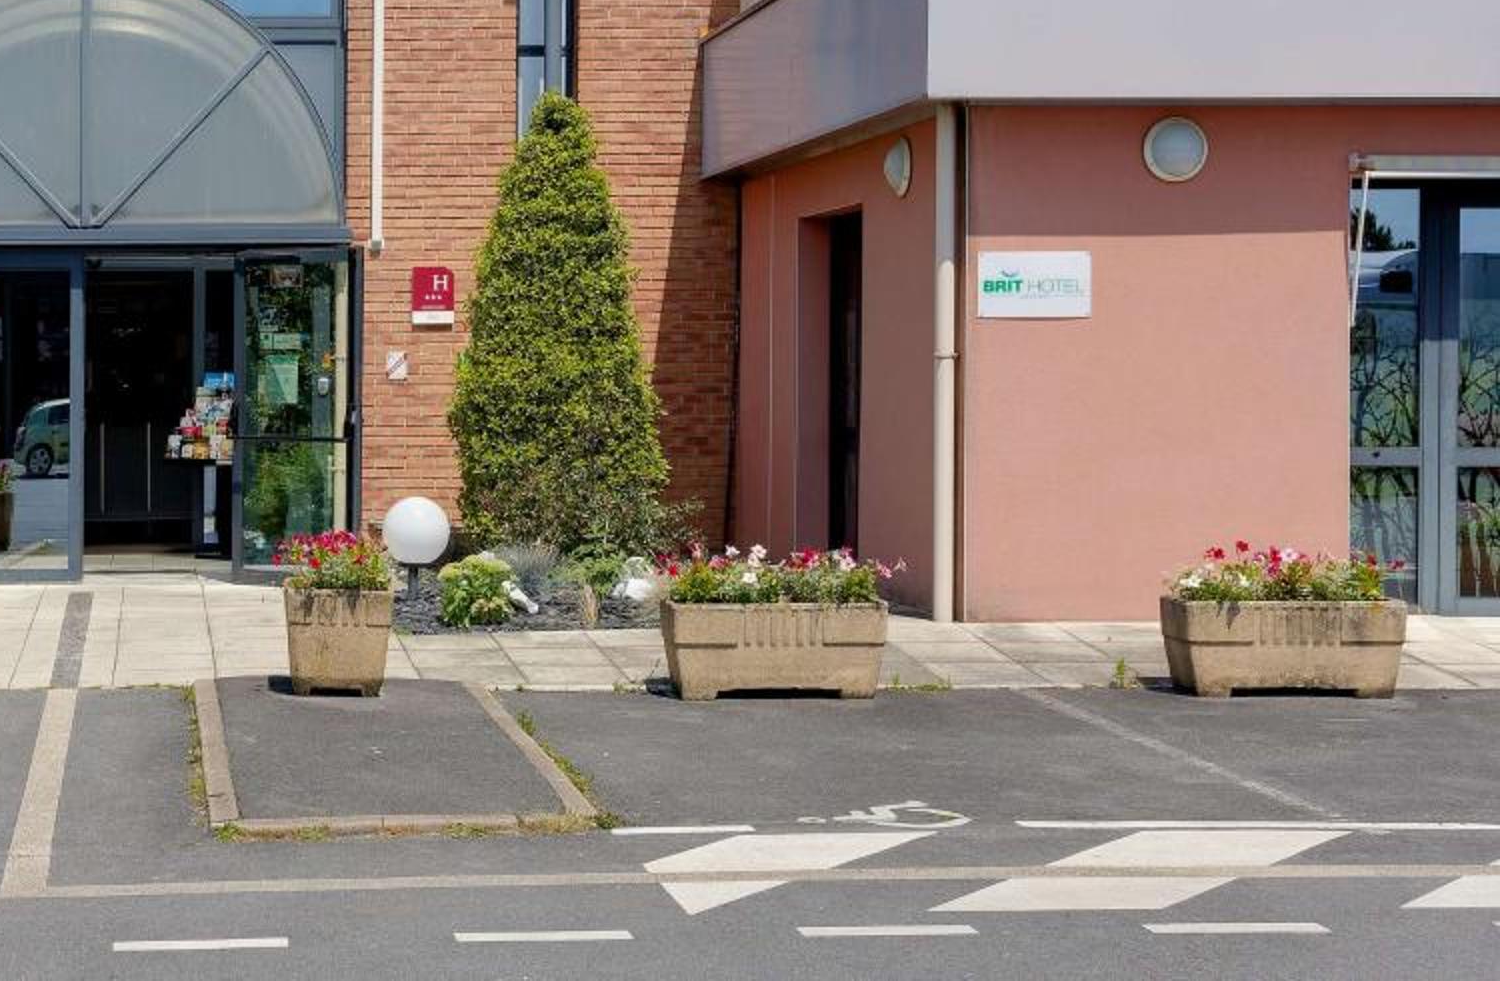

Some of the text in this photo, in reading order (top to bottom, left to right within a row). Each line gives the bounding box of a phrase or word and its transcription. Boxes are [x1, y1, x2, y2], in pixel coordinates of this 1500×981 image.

[433, 274, 449, 291] H
[983, 279, 1084, 294] BRIT HOTEL
